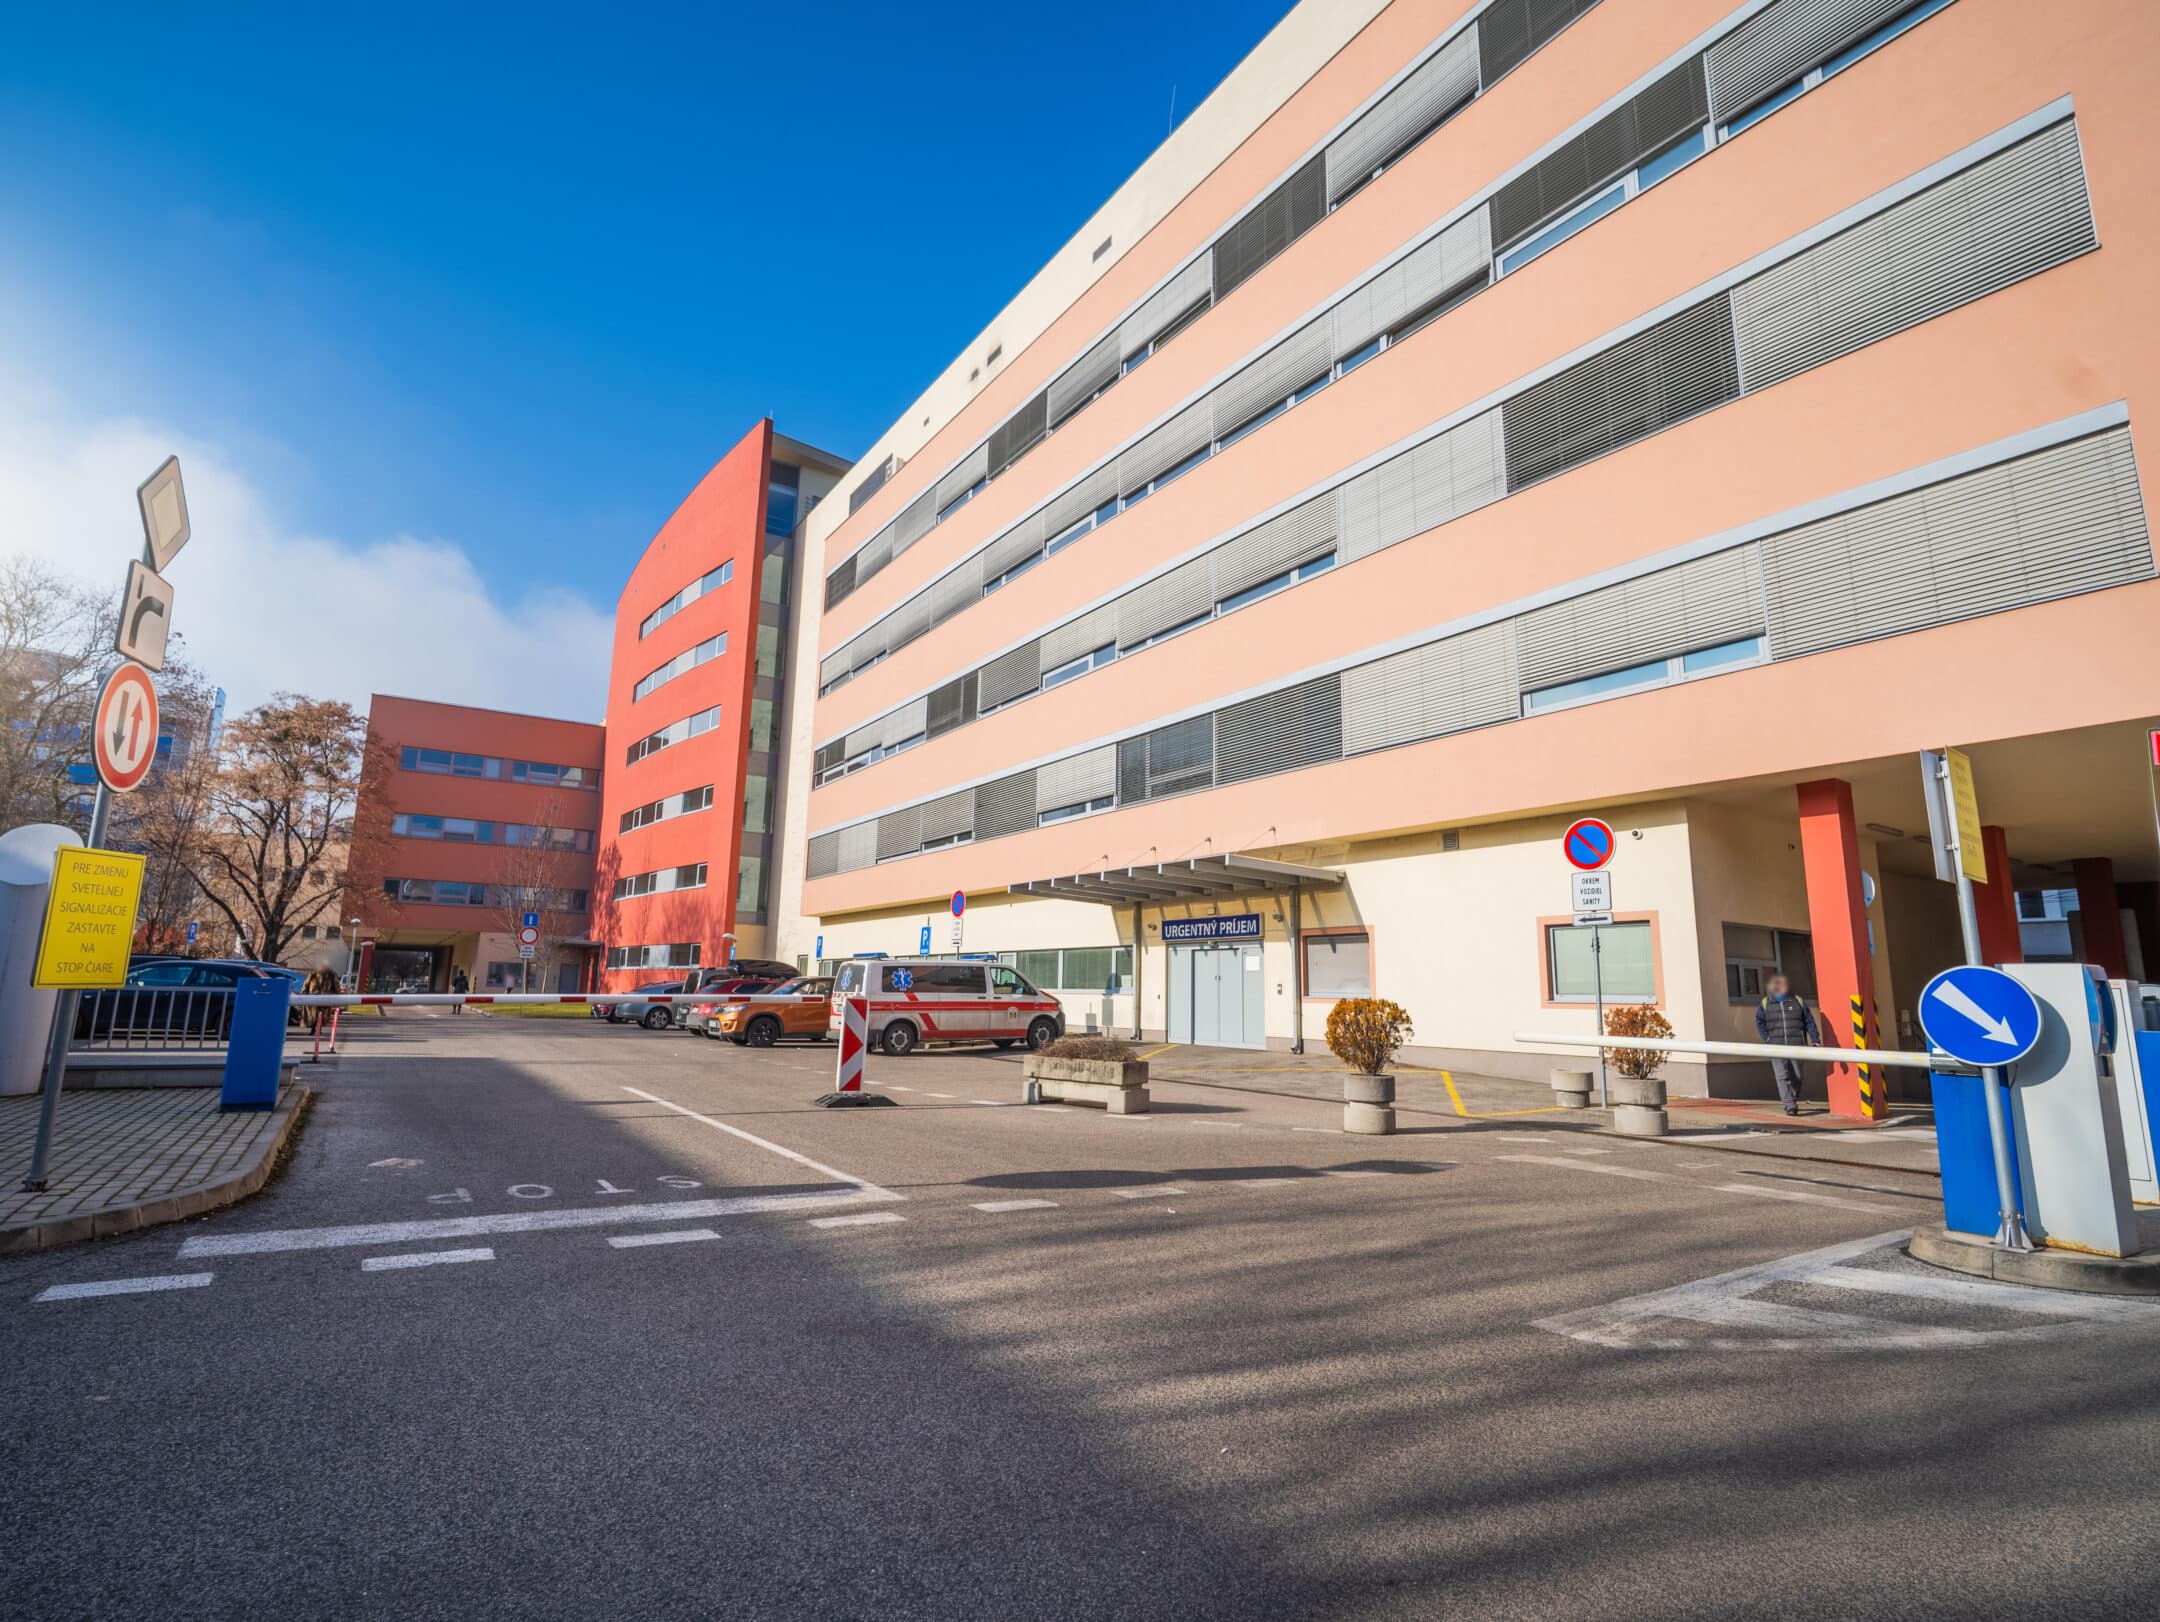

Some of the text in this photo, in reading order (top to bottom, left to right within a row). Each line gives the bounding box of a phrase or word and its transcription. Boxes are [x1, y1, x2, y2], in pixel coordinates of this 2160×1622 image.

[72, 862, 129, 879] PRE ZMENU
[1581, 877, 1600, 885] OKREM
[71, 882, 124, 897] SVETELNEJ
[1580, 887, 1602, 895] VOZIDIEL
[66, 922, 117, 935] ZASTAVTE
[1165, 918, 1256, 937] URGENTNÝ PRÍJEM
[80, 943, 95, 953] NA
[56, 960, 113, 974] STOP ČIARE
